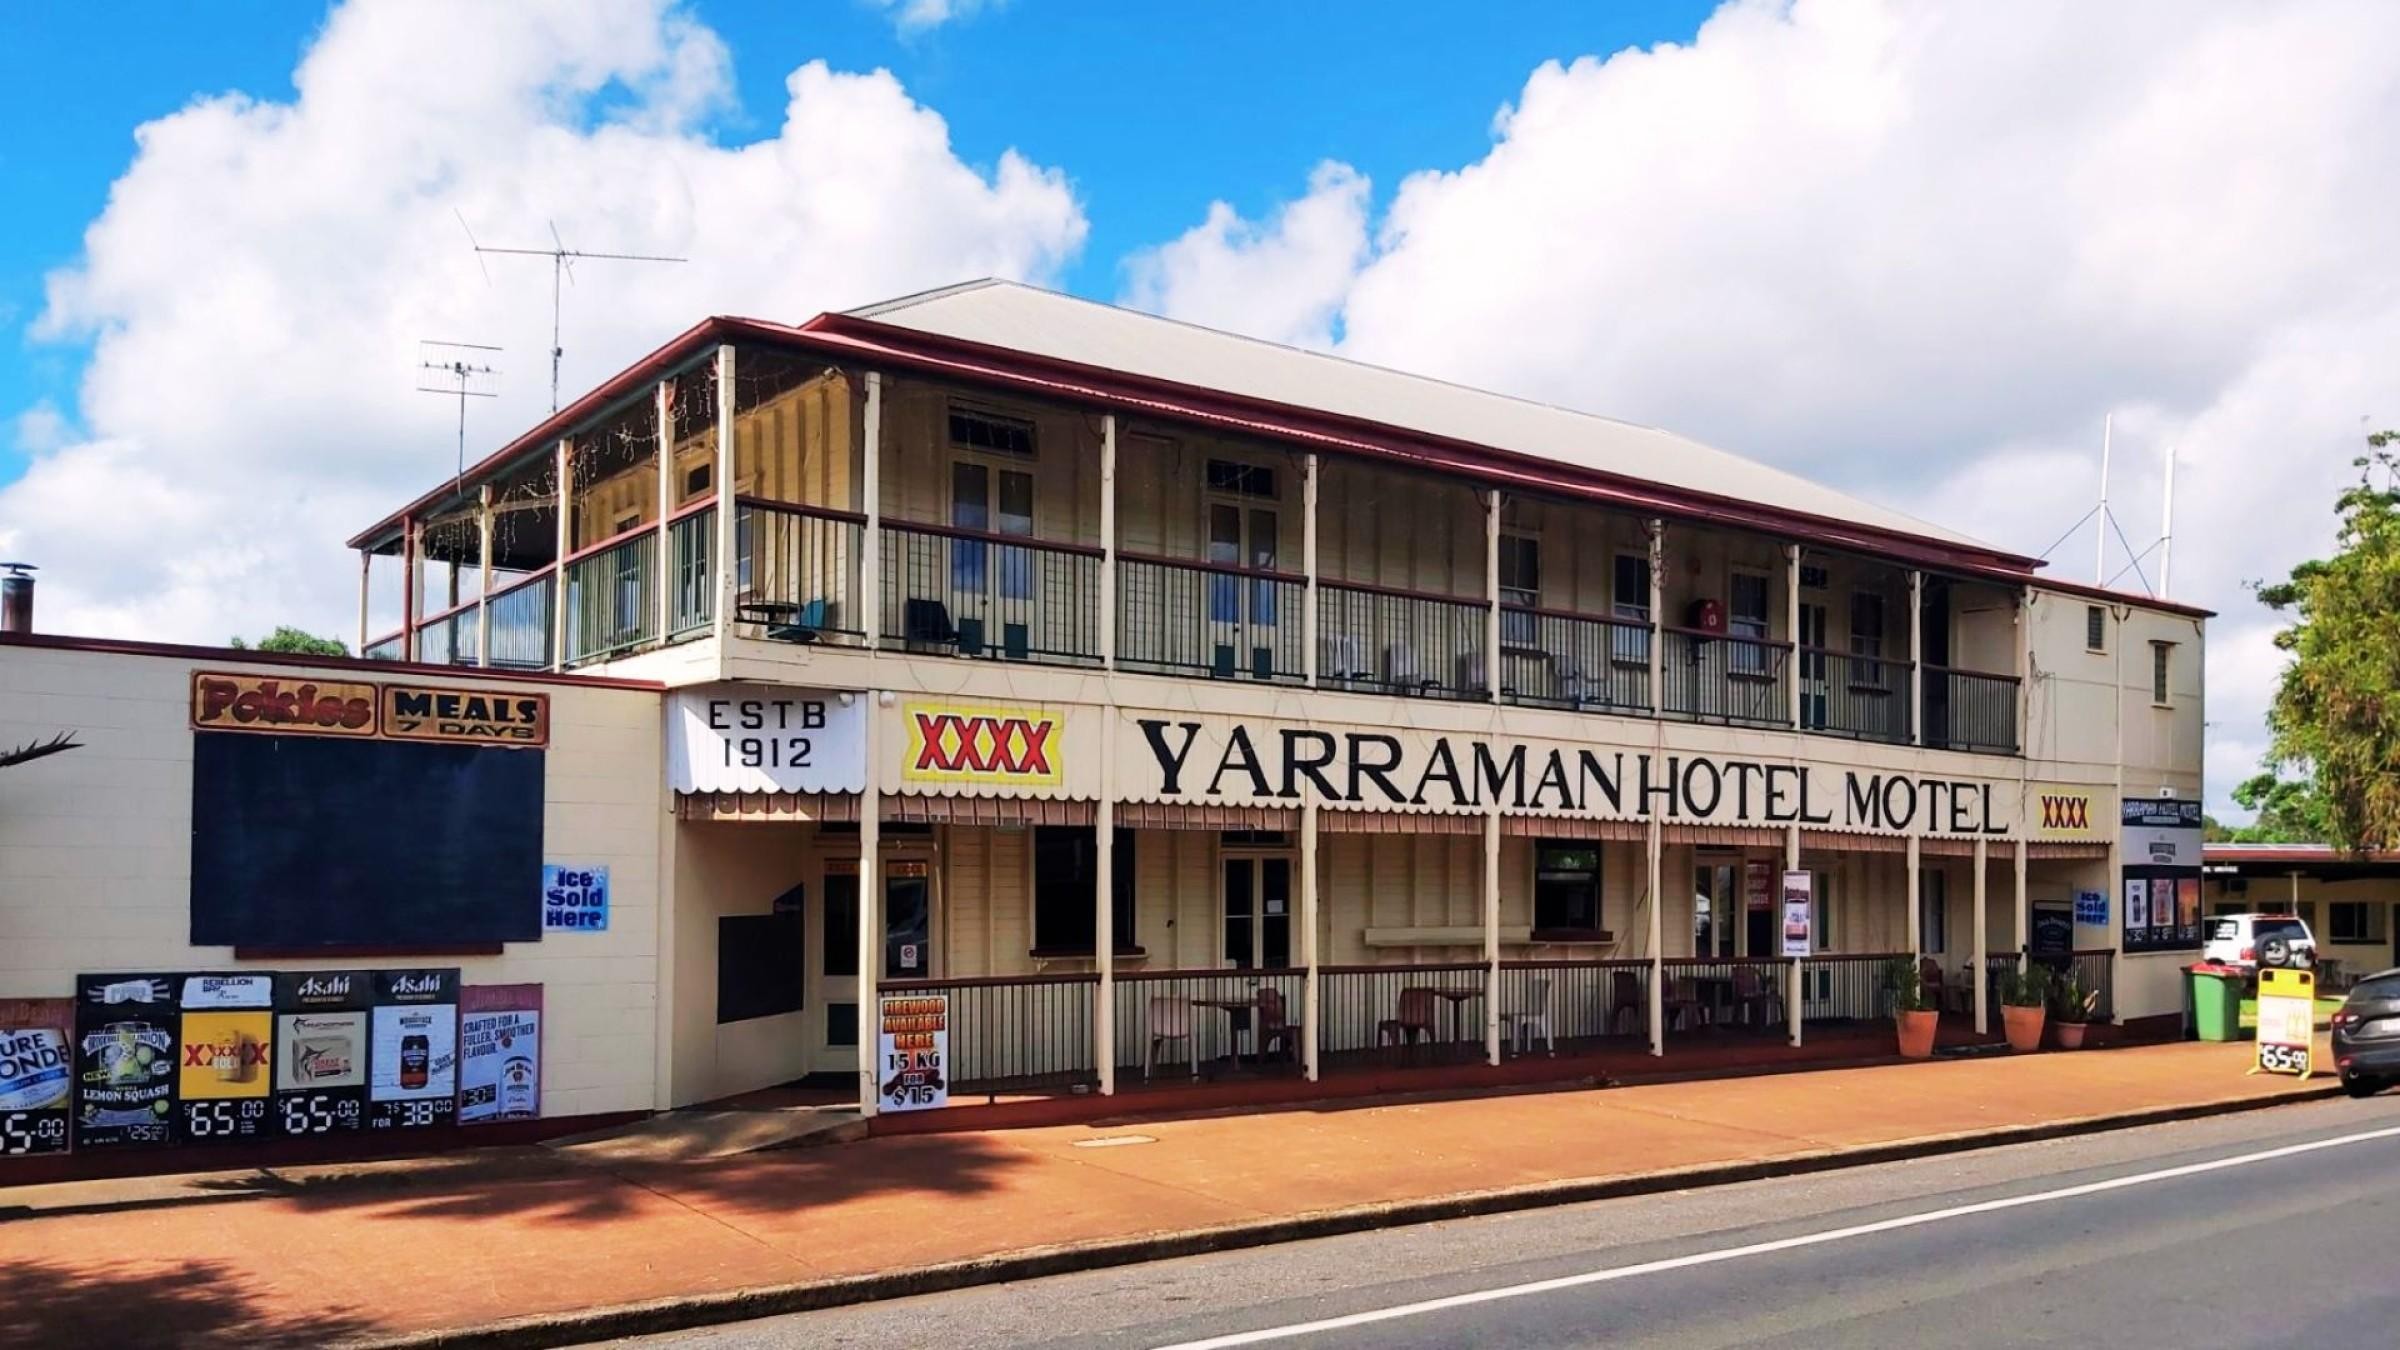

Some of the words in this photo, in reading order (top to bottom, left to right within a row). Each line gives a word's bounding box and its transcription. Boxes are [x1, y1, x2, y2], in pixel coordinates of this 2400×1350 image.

[200, 678, 371, 729] Pokies
[395, 692, 537, 723] MEALS
[709, 700, 826, 731] ESTB
[397, 720, 421, 732] 7
[440, 722, 535, 739] DAYS
[725, 738, 811, 768] 1912
[915, 713, 1052, 774] XXXX
[1137, 719, 1622, 814] YARRAMAN
[1639, 754, 1833, 823] HOTEL
[1845, 771, 2008, 834] MOTEL
[2041, 796, 2088, 829] XXXX
[557, 868, 593, 887] Ice
[547, 888, 603, 907] Sold
[2081, 892, 2100, 901] Ice
[2076, 902, 2106, 913] Sold
[546, 909, 602, 927] Here
[298, 975, 351, 996] Asahi
[391, 974, 441, 994] Asahi
[884, 1000, 945, 1015] FIREWOOD
[464, 1018, 496, 1034] CRAFTED
[499, 1015, 512, 1027] FOR
[515, 1014, 519, 1024] A
[495, 1023, 535, 1041] SMOOTHER
[884, 1015, 945, 1033] AVAILABLE
[895, 1033, 934, 1049] HERE
[888, 1054, 909, 1070] 15
[916, 1052, 941, 1068] KG
[83, 1088, 121, 1102] LEMON
[124, 1083, 169, 1103] SQUASH
